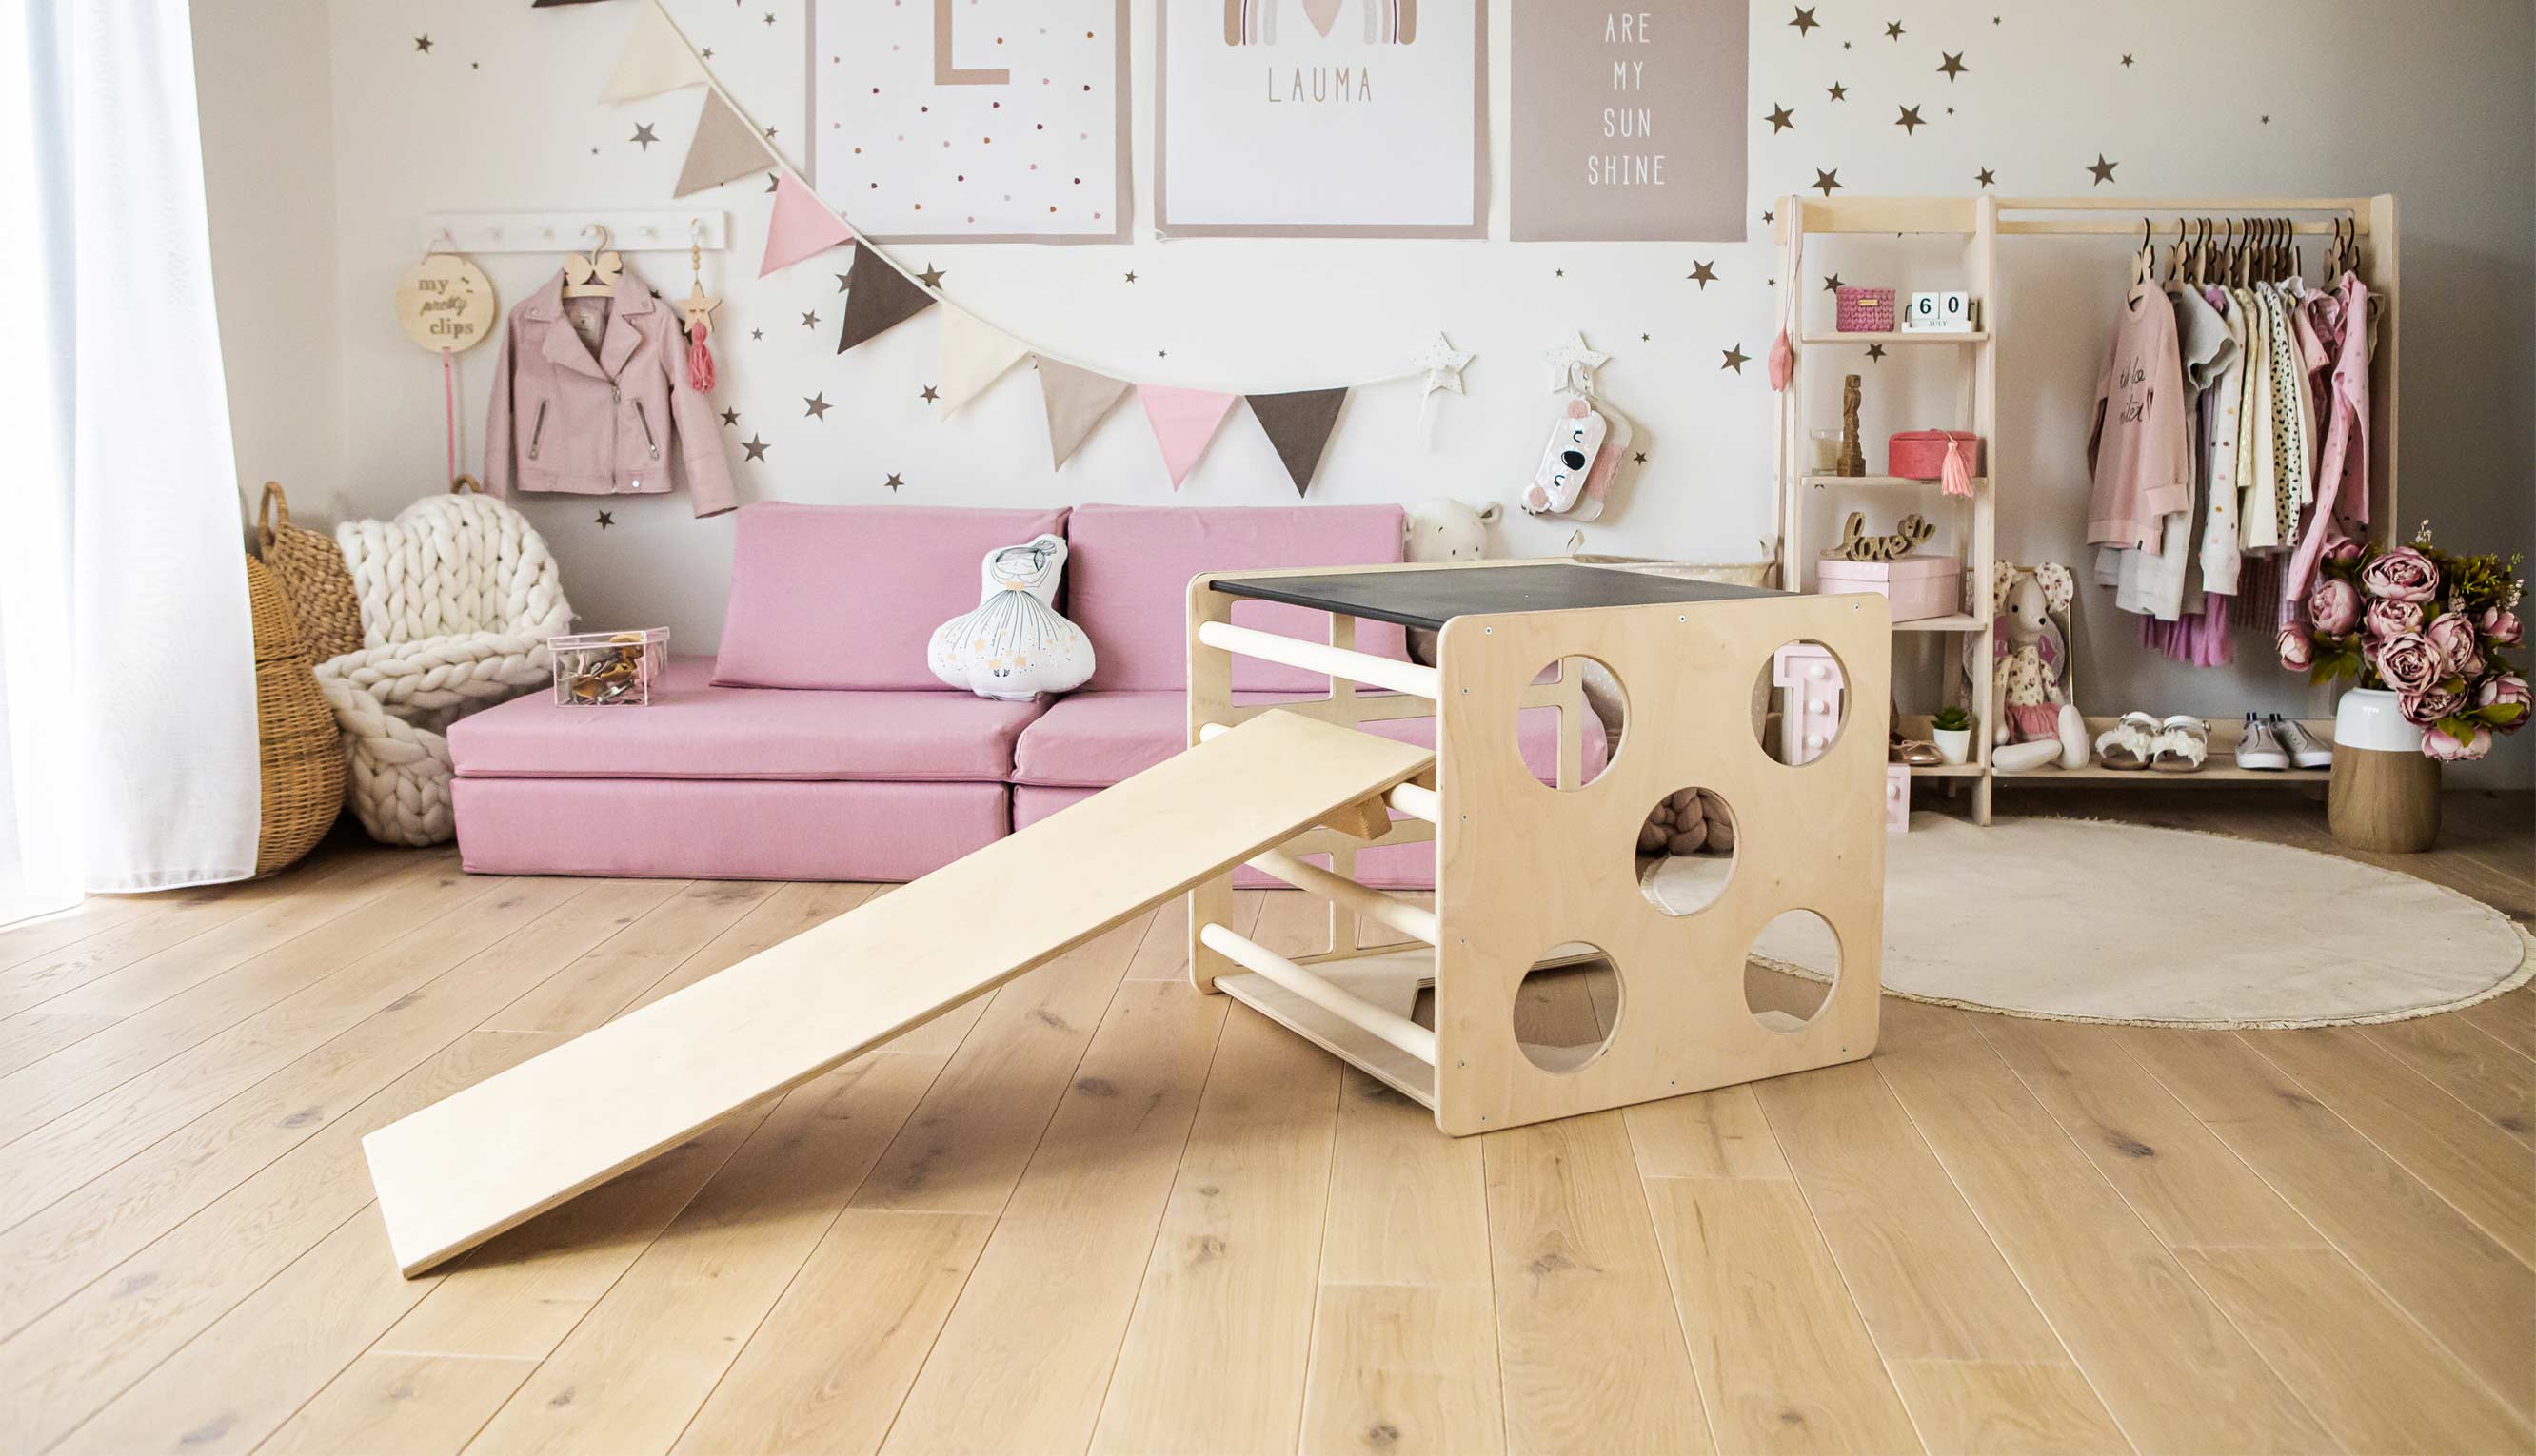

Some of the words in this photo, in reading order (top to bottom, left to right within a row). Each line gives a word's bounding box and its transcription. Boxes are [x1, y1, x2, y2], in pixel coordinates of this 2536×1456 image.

[1605, 12, 1651, 43] ARE
[1268, 66, 1371, 103] LAUMA
[1614, 60, 1644, 91] MY
[1604, 108, 1651, 138] SUN
[1588, 155, 1665, 185] SHINE
[418, 279, 449, 295] my
[429, 317, 474, 339] clips
